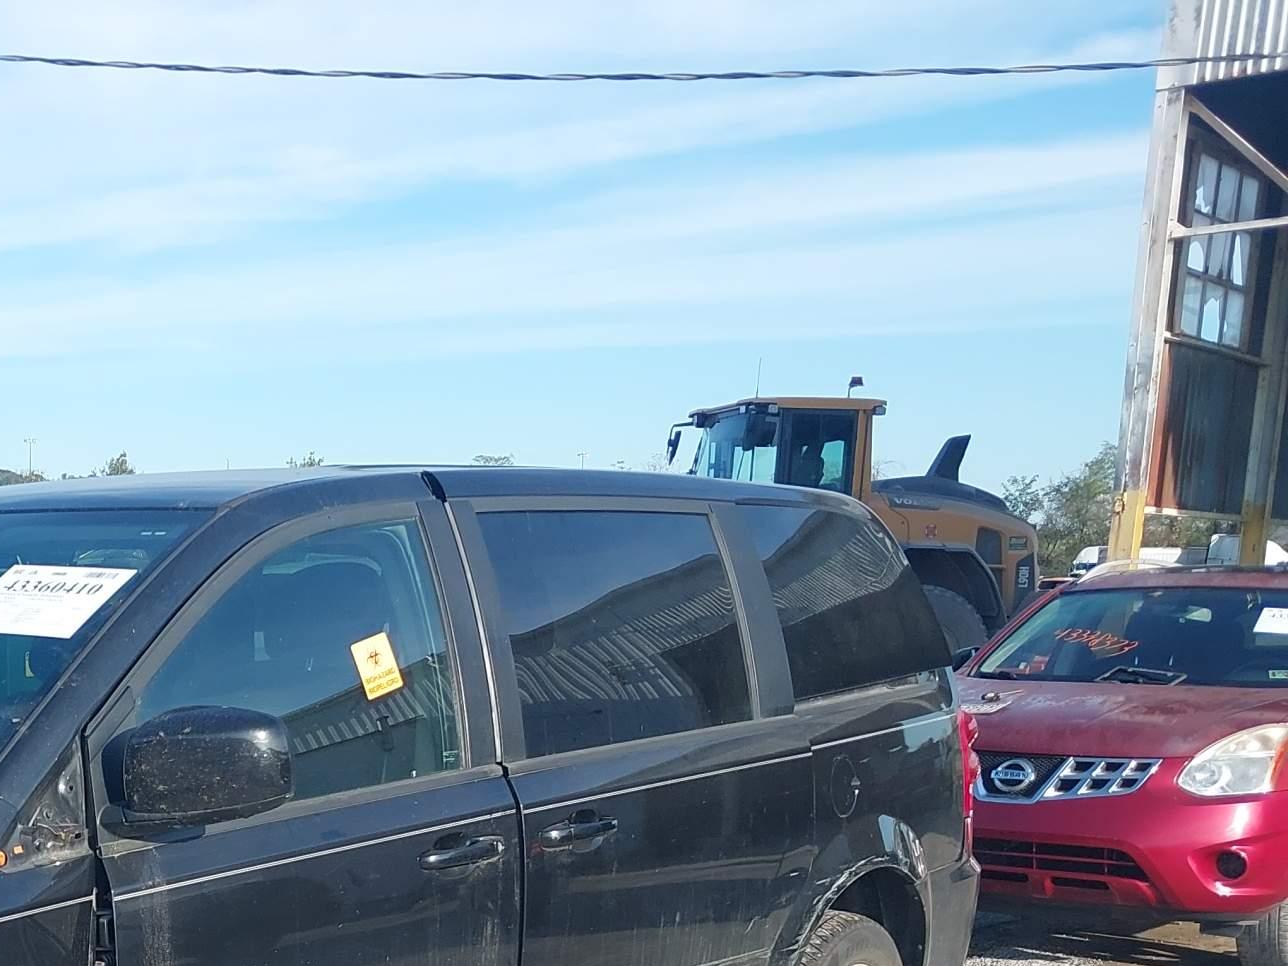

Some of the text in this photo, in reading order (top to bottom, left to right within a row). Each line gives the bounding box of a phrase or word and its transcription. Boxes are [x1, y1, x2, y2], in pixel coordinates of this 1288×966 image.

[1018, 566, 1030, 588] L90H
[4, 579, 104, 595] 43360410
[994, 771, 1028, 779] NISSAN
